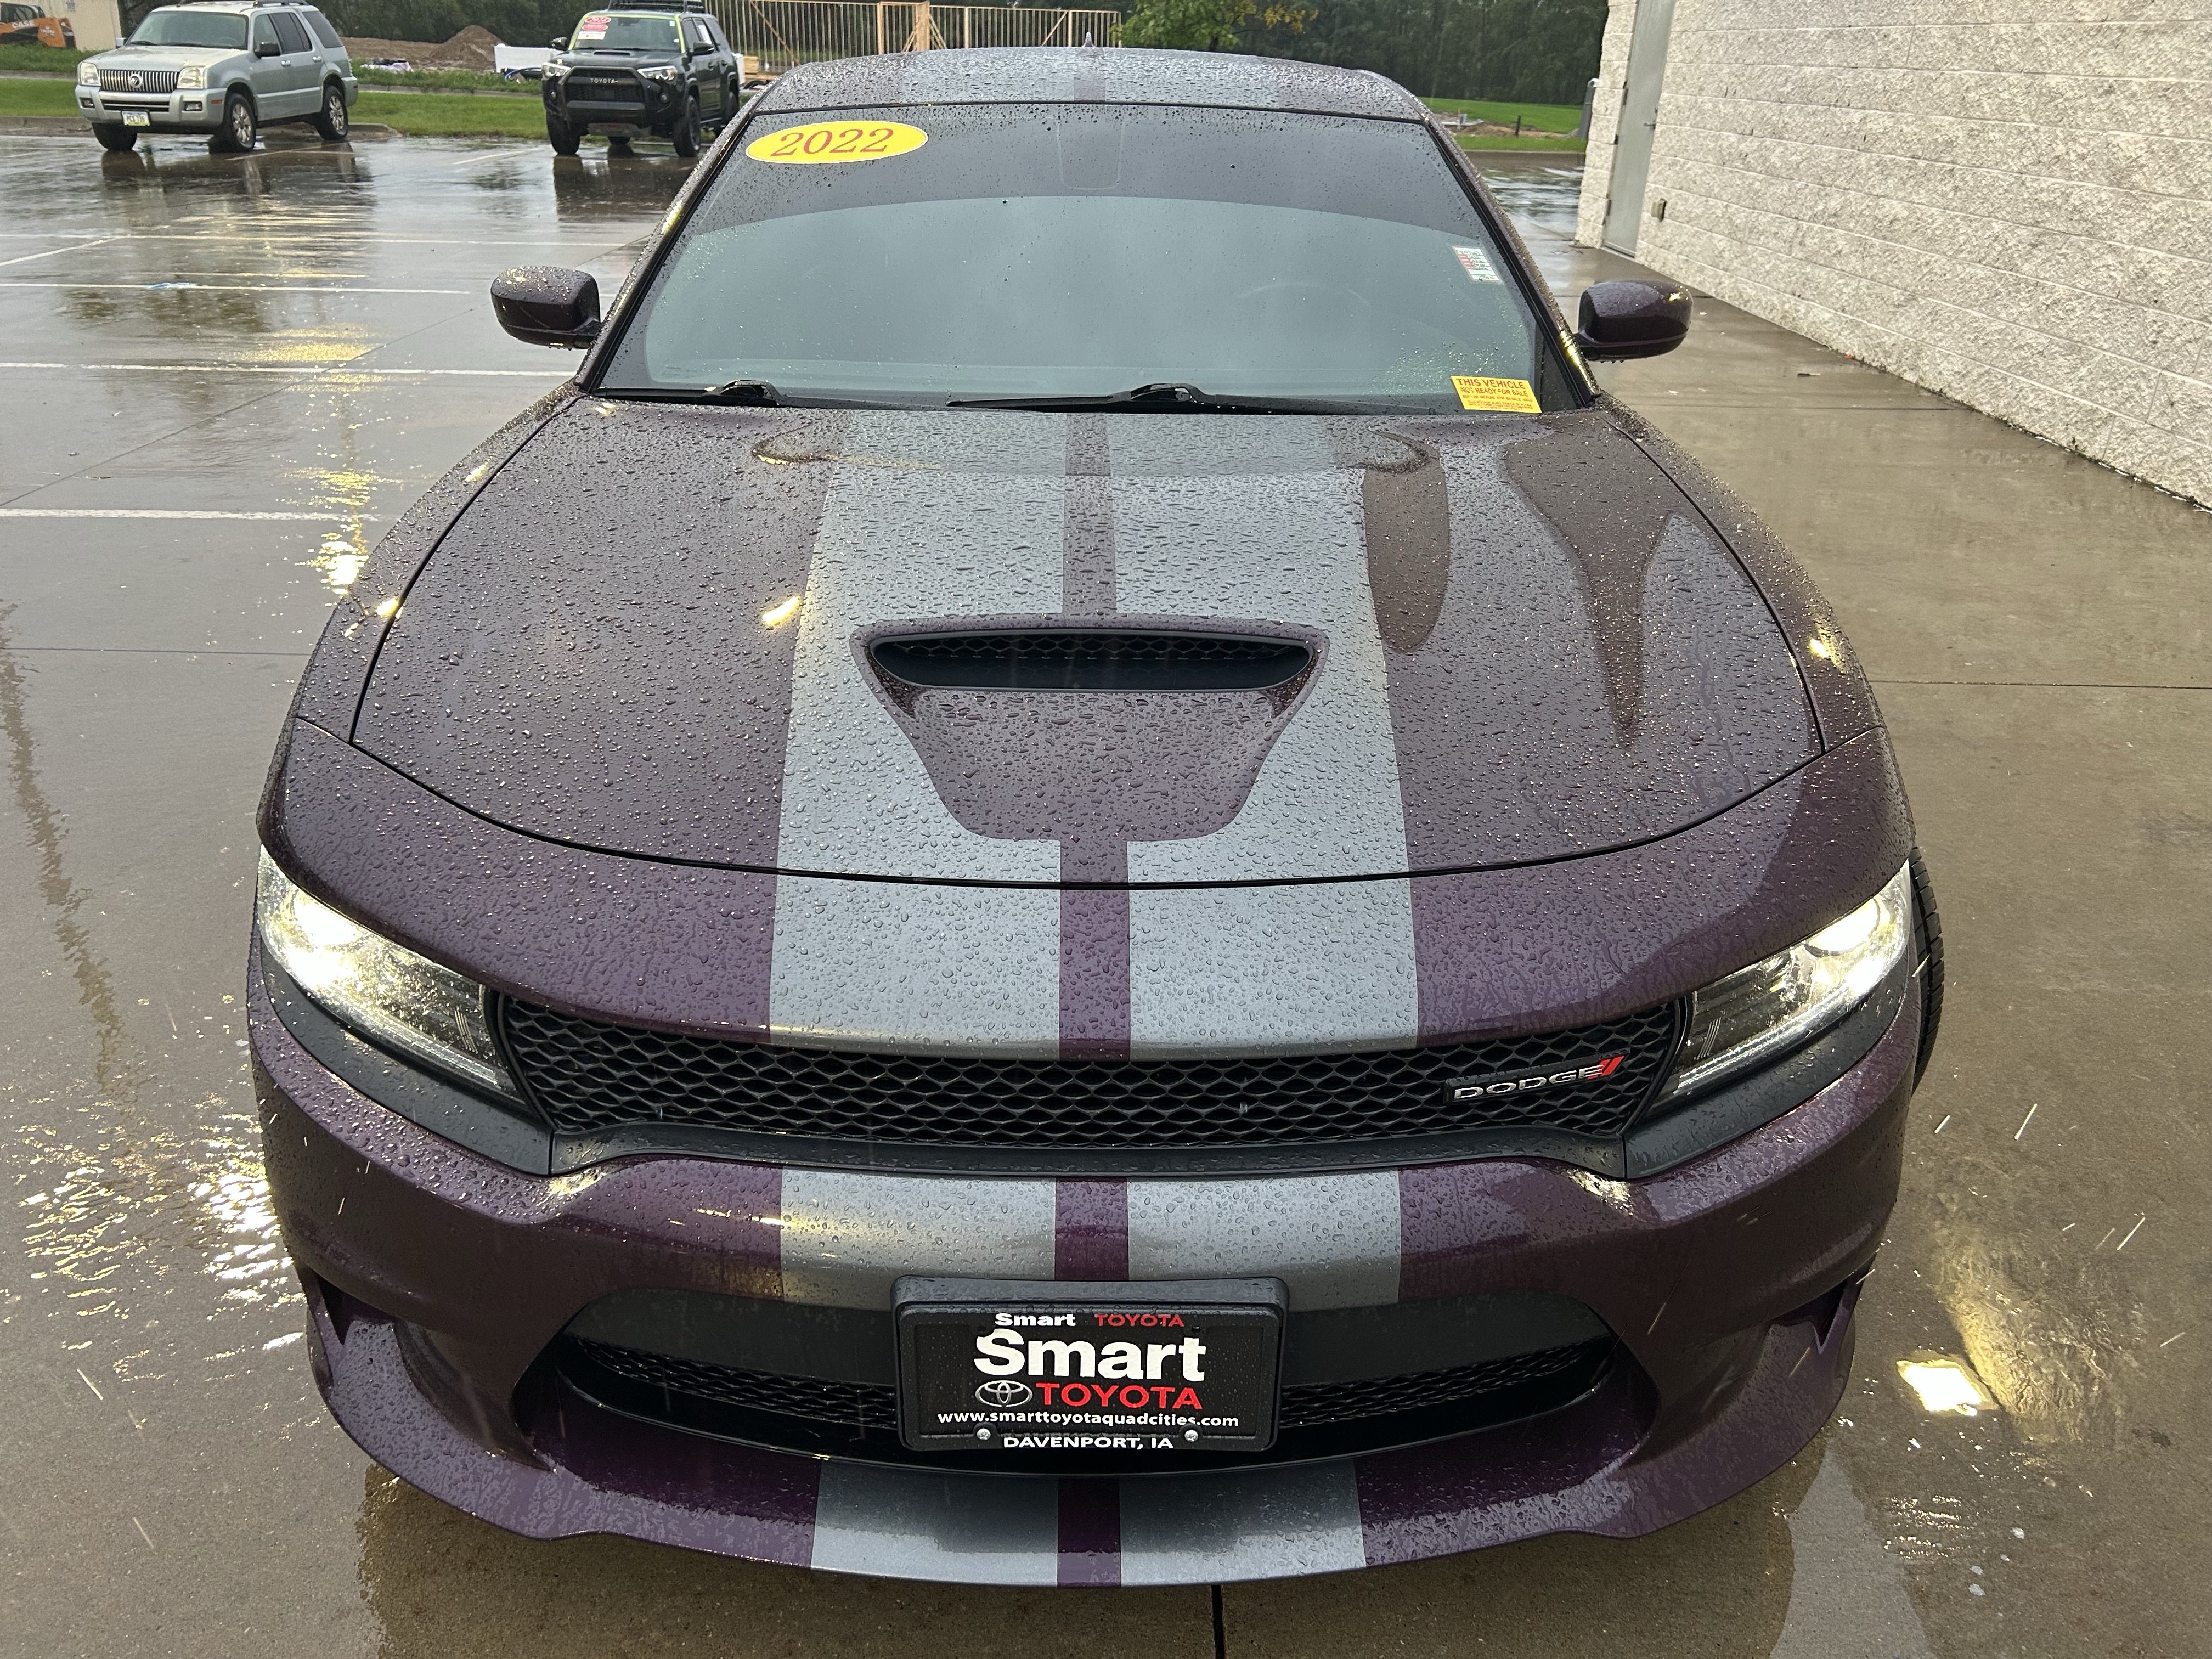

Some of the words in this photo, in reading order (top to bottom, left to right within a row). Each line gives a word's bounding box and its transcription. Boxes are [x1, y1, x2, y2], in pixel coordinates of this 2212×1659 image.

[770, 128, 894, 157] 2022
[1456, 378, 1481, 386] THIS
[1482, 379, 1526, 389] VEHICLE
[1454, 1064, 1604, 1099] DODGE
[995, 1313, 1076, 1327] Smart
[1094, 1314, 1185, 1327] TOYOTA
[974, 1328, 1206, 1382] Smart
[1036, 1382, 1203, 1410] TOYOTA
[938, 1410, 1239, 1427] www.smarttoyotaquadcities.com
[1003, 1436, 1144, 1450] DAVENPORT,
[1151, 1437, 1173, 1449] IA
